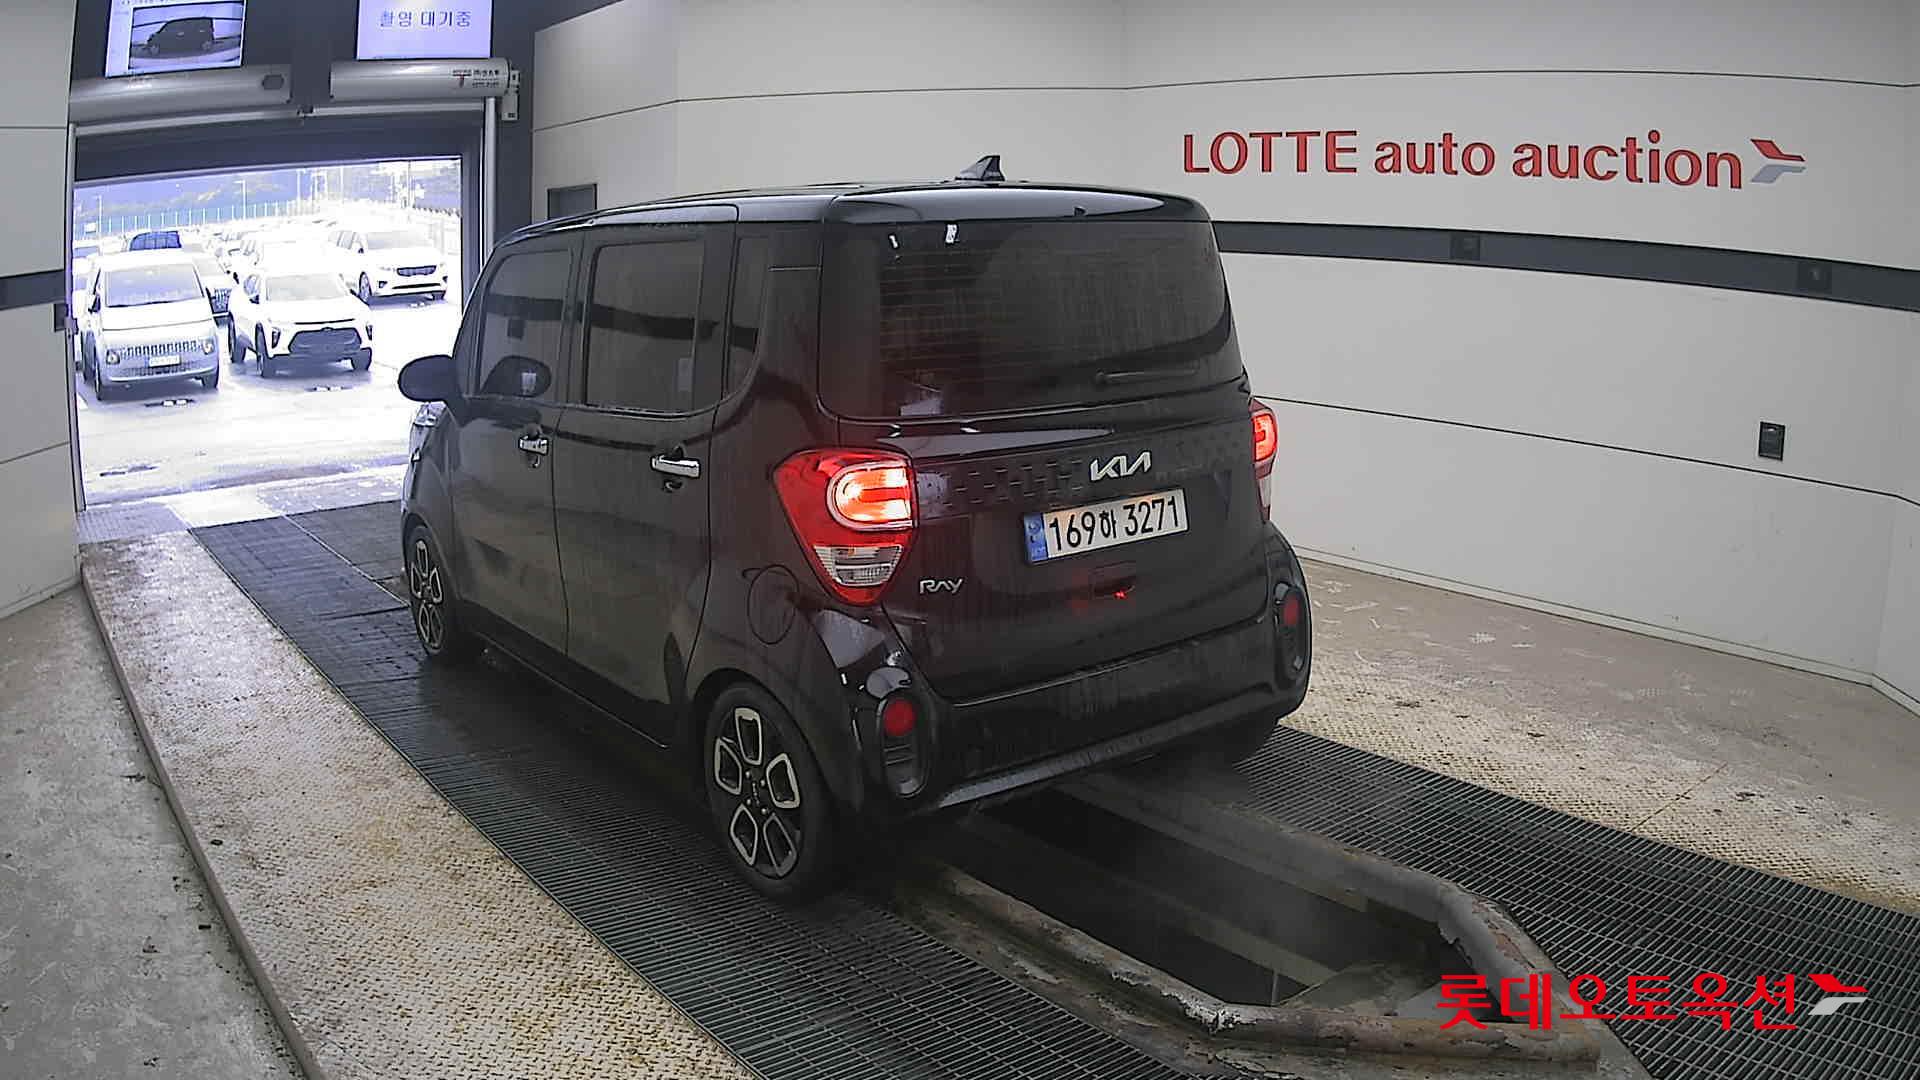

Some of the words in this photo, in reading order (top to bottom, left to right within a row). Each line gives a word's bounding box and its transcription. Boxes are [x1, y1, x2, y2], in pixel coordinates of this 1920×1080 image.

[421, 11, 472, 27] 대기중
[1183, 130, 1357, 174] LOTTE
[1374, 132, 1496, 176] auto
[1512, 130, 1742, 188] auction
[1090, 451, 1152, 481] KIA
[1049, 509, 1117, 551] 169하
[1123, 495, 1179, 537] 3271
[919, 578, 963, 594] RAY
